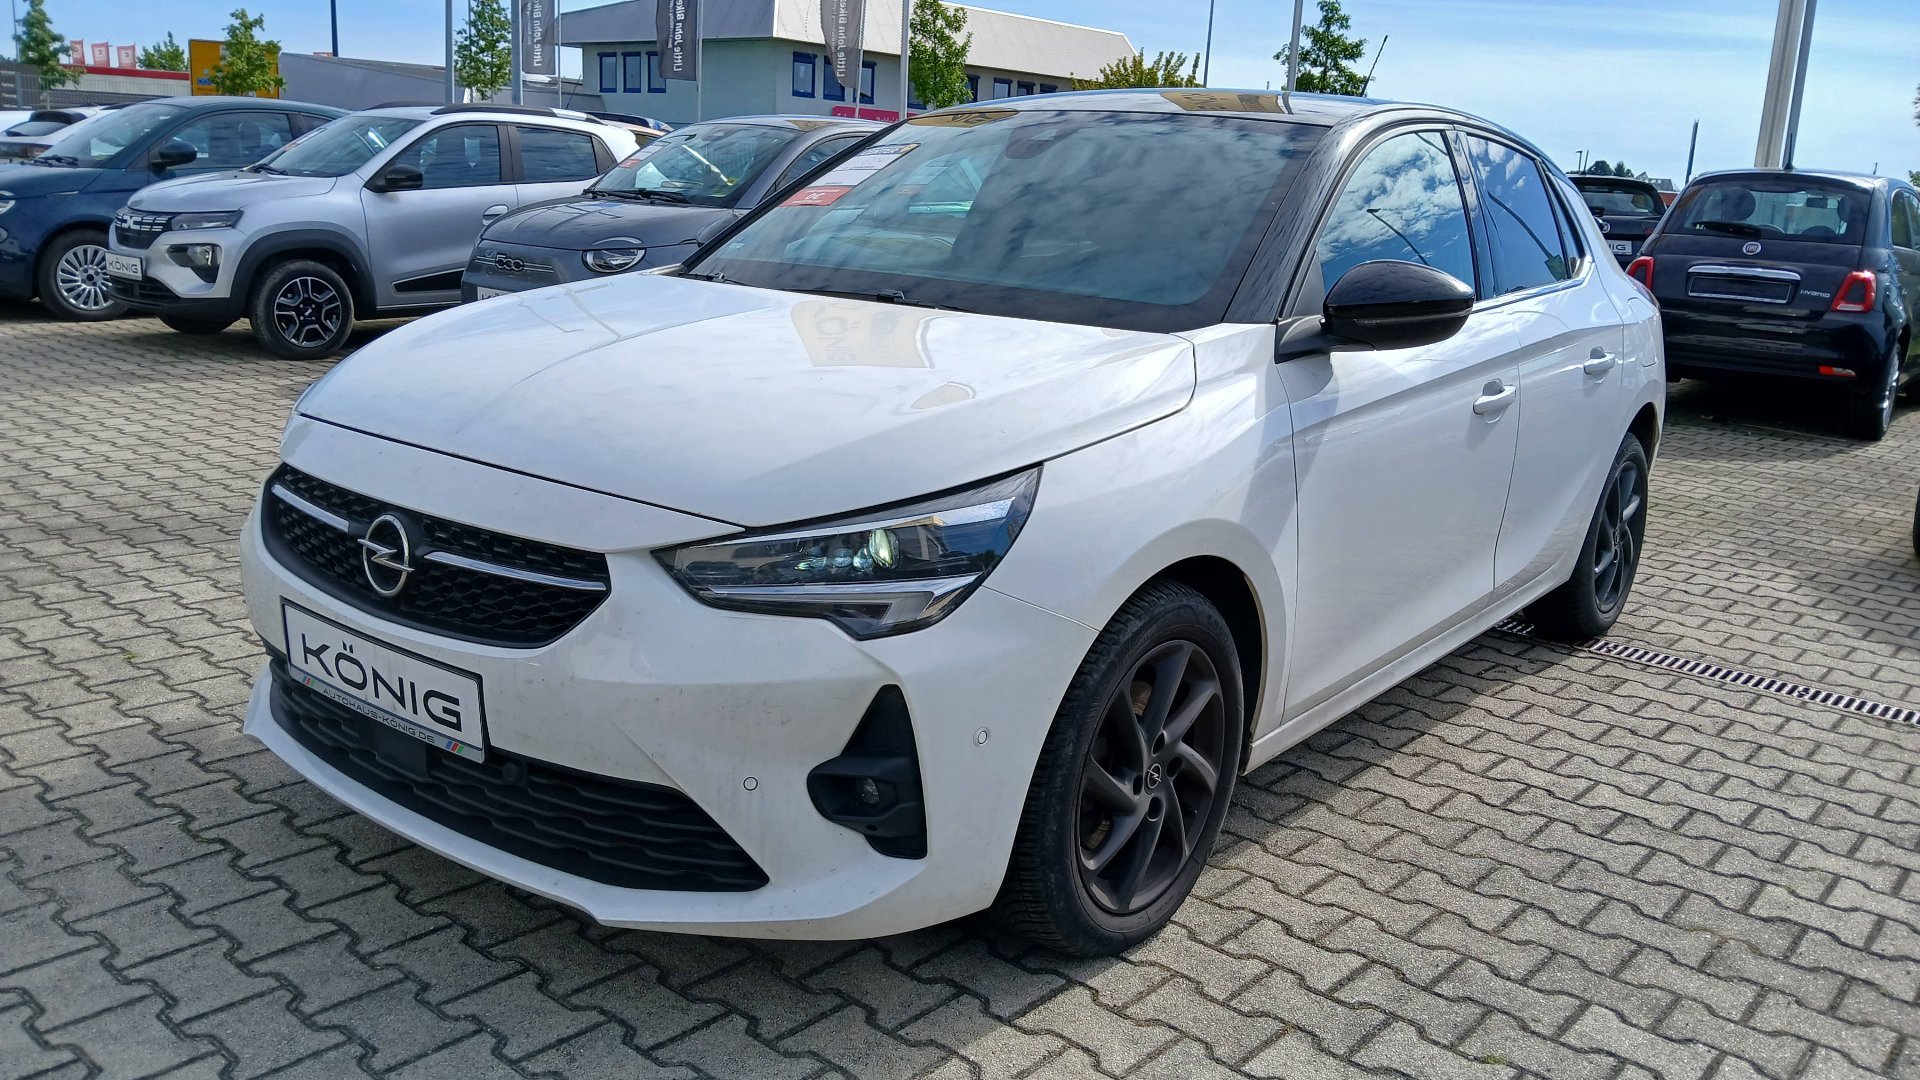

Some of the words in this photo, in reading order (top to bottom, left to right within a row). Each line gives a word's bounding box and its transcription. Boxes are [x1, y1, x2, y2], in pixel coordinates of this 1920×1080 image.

[108, 257, 139, 274] KÖNIG
[496, 254, 524, 271] 500
[301, 633, 463, 733] KÖNIG
[323, 687, 435, 744] AUTOHAUS-KÖNIG.DE
